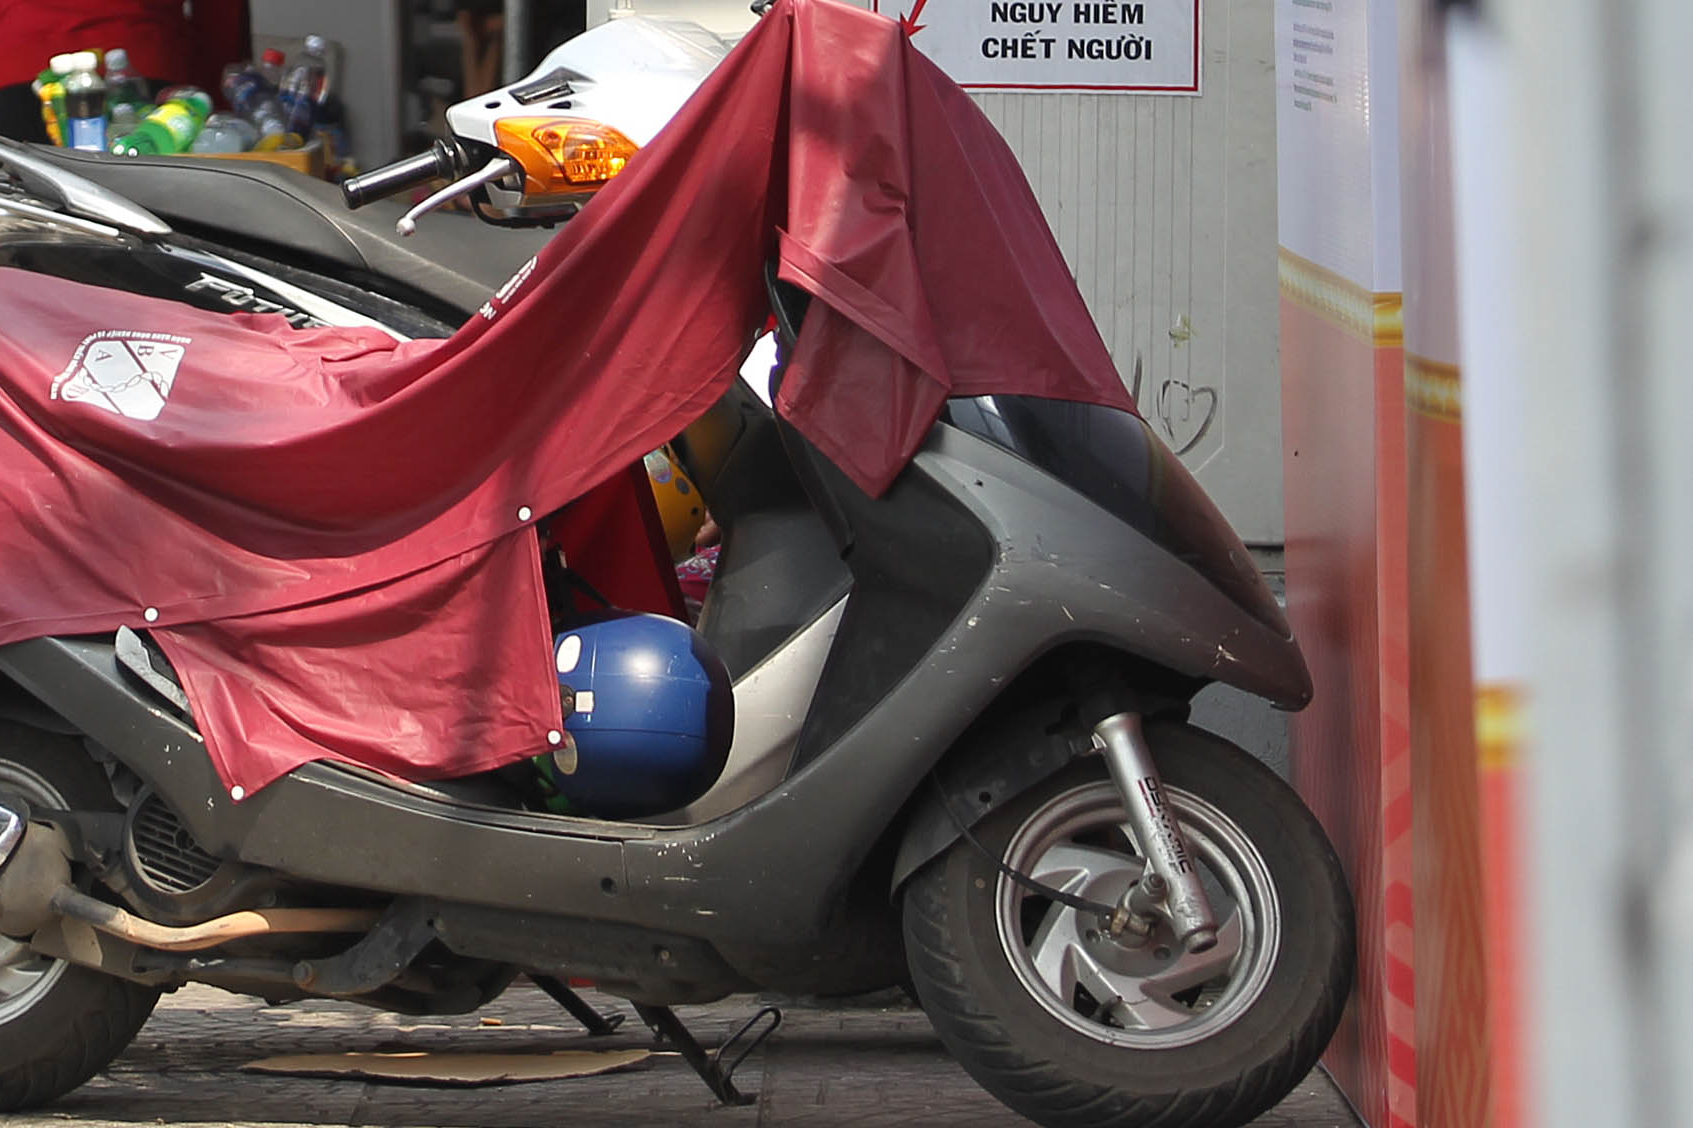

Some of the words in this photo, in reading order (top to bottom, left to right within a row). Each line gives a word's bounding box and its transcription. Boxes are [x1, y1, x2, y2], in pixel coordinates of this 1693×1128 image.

[991, 2, 1063, 23] NGUY
[981, 30, 1056, 60] CHẾT
[1067, 33, 1152, 61] NGƯỜI
